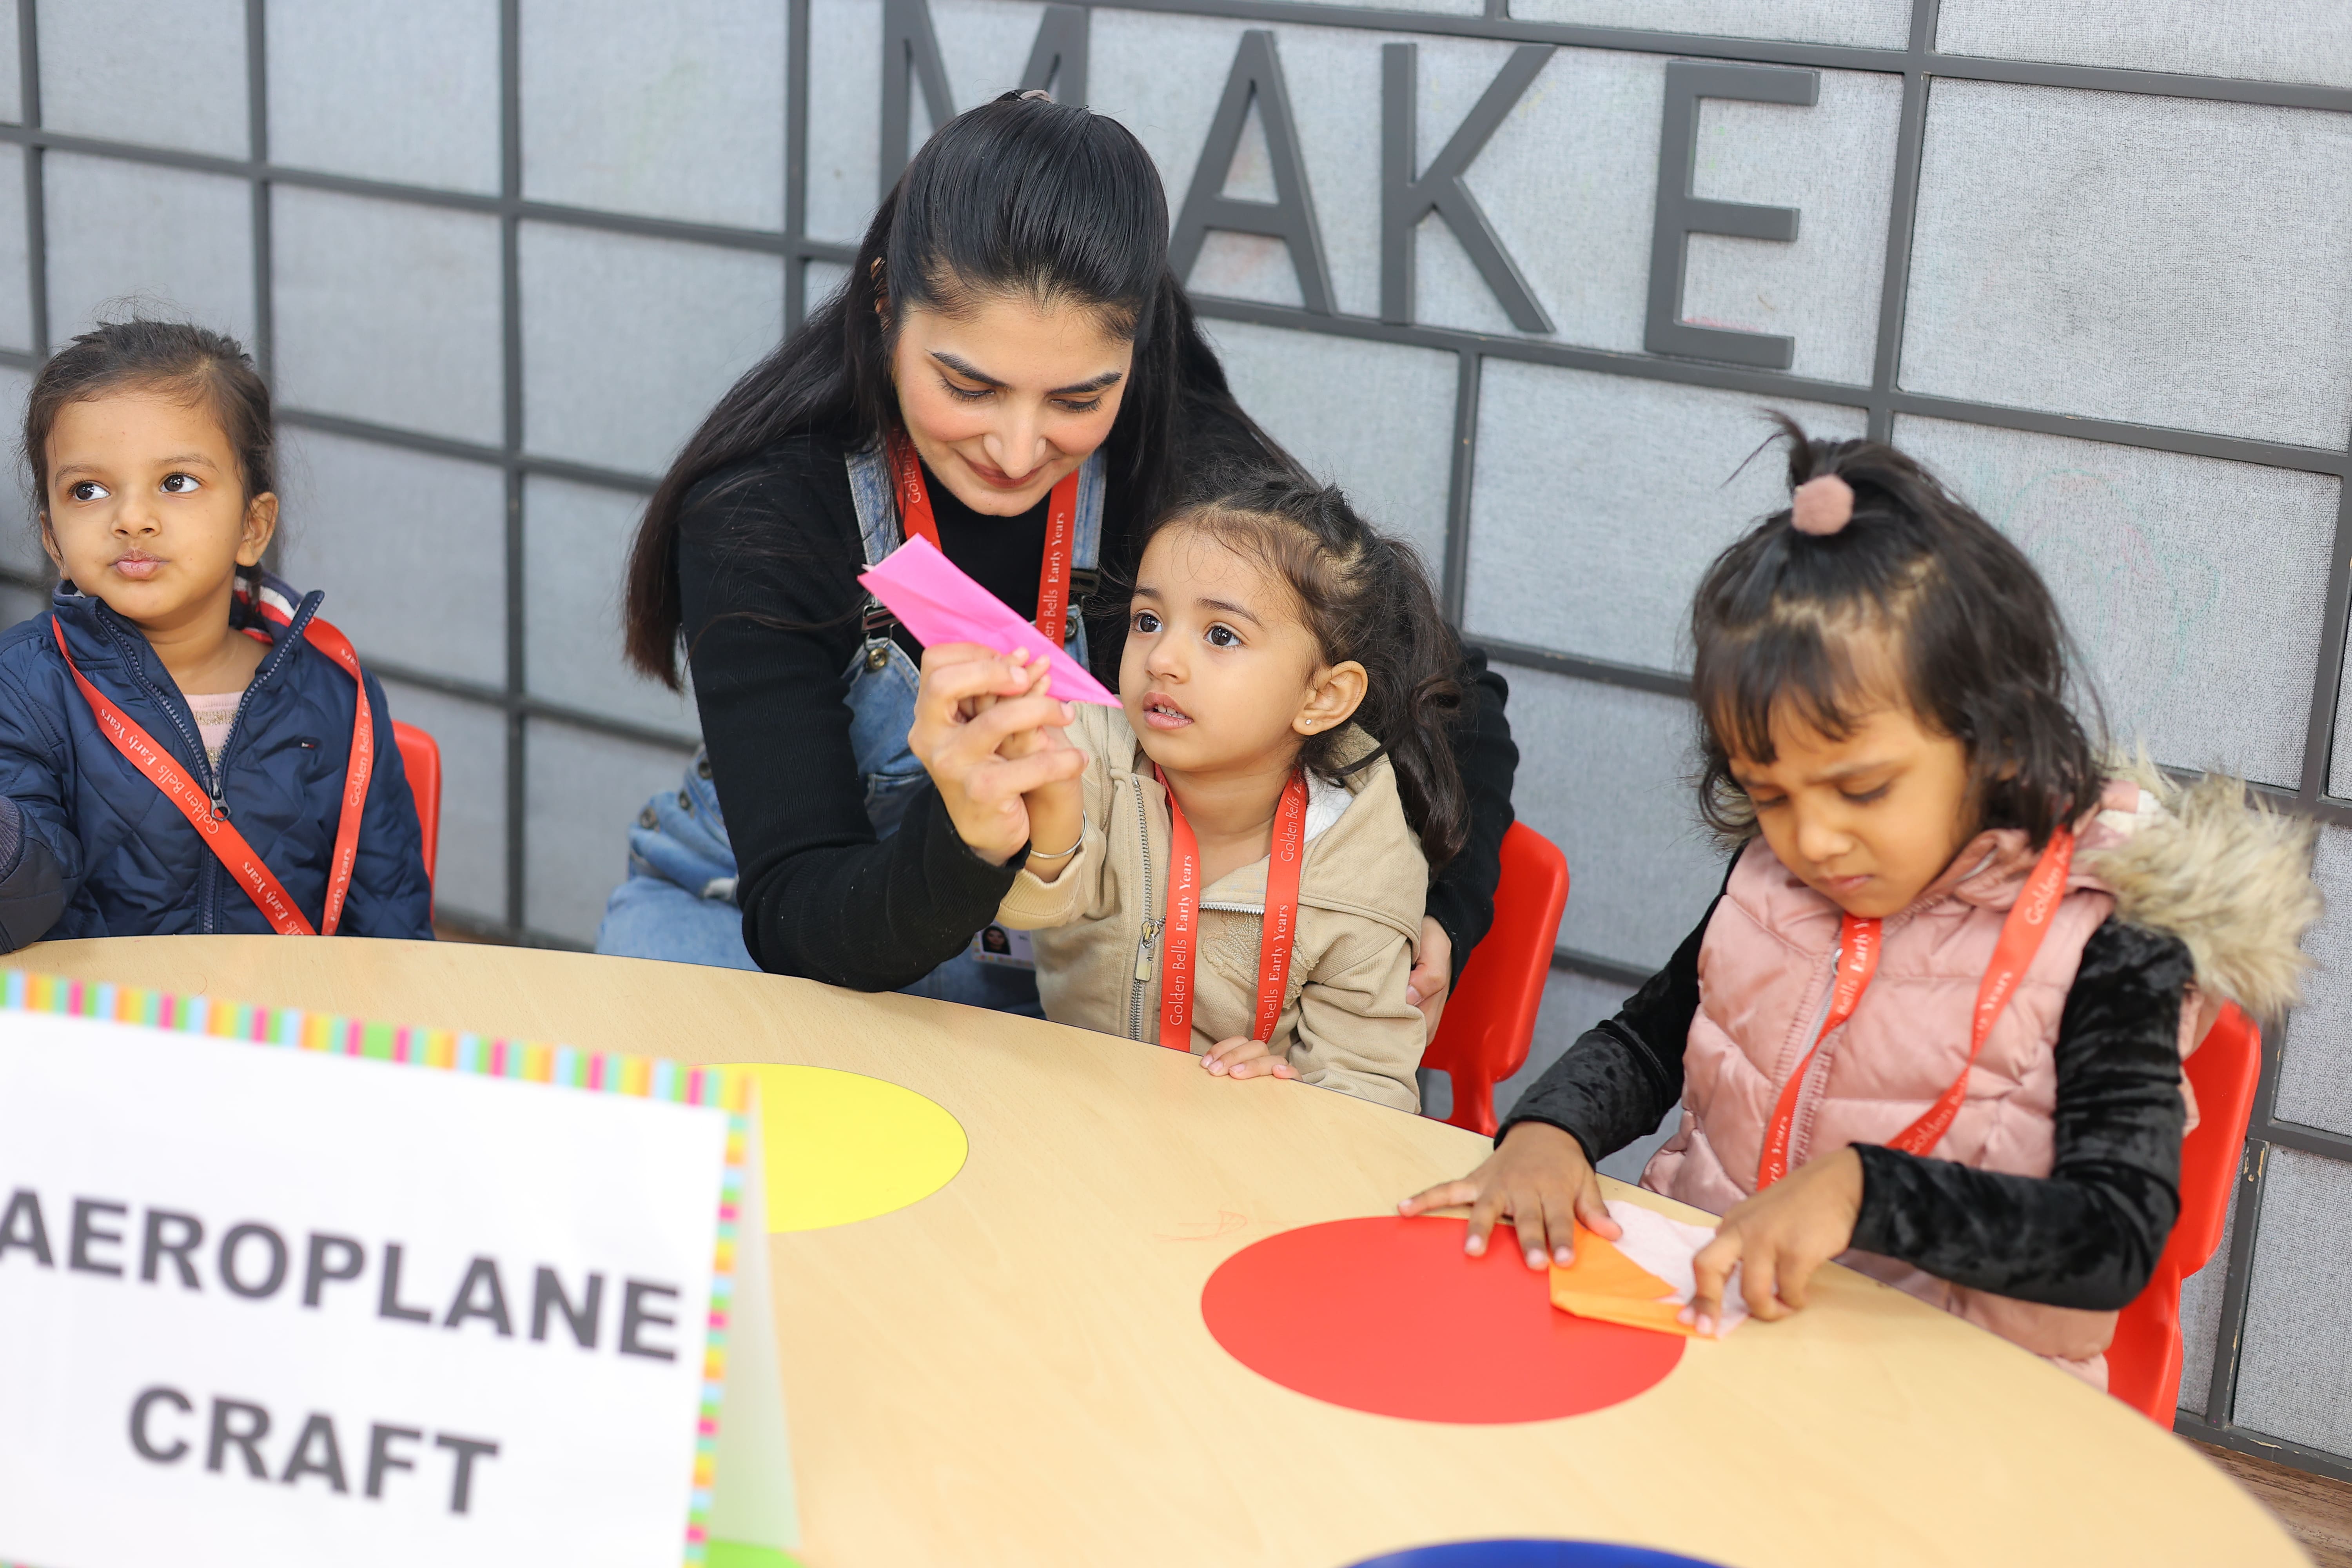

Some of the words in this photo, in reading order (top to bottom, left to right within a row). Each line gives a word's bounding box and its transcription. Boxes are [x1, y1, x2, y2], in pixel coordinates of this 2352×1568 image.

[1051, 512, 1065, 546] Years
[1048, 551, 1063, 583] Early
[1043, 589, 1058, 617] Bells
[100, 708, 126, 740] Years
[358, 723, 370, 755] Bells
[126, 734, 157, 766] Early
[158, 765, 185, 794] Bells
[350, 756, 368, 807] Golden
[185, 790, 219, 835] Golden
[1285, 796, 1299, 819] Bells
[1279, 821, 1298, 862] Golden
[242, 861, 267, 894] Years
[337, 848, 351, 883] Years
[1179, 855, 1192, 890] Years
[265, 891, 289, 920] Early
[1175, 895, 1193, 932] Early
[2024, 867, 2063, 926] Golden
[1273, 904, 1289, 940] Years
[1171, 939, 1187, 970] Bells
[1268, 945, 1287, 982] Early
[1836, 978, 1859, 1016] Bells
[1849, 933, 1874, 973] Early
[1168, 975, 1186, 1026] Golden
[1263, 989, 1279, 1019] Bells
[0, 1188, 682, 1363] AEROPLANE
[127, 1385, 500, 1516] CRAFT
